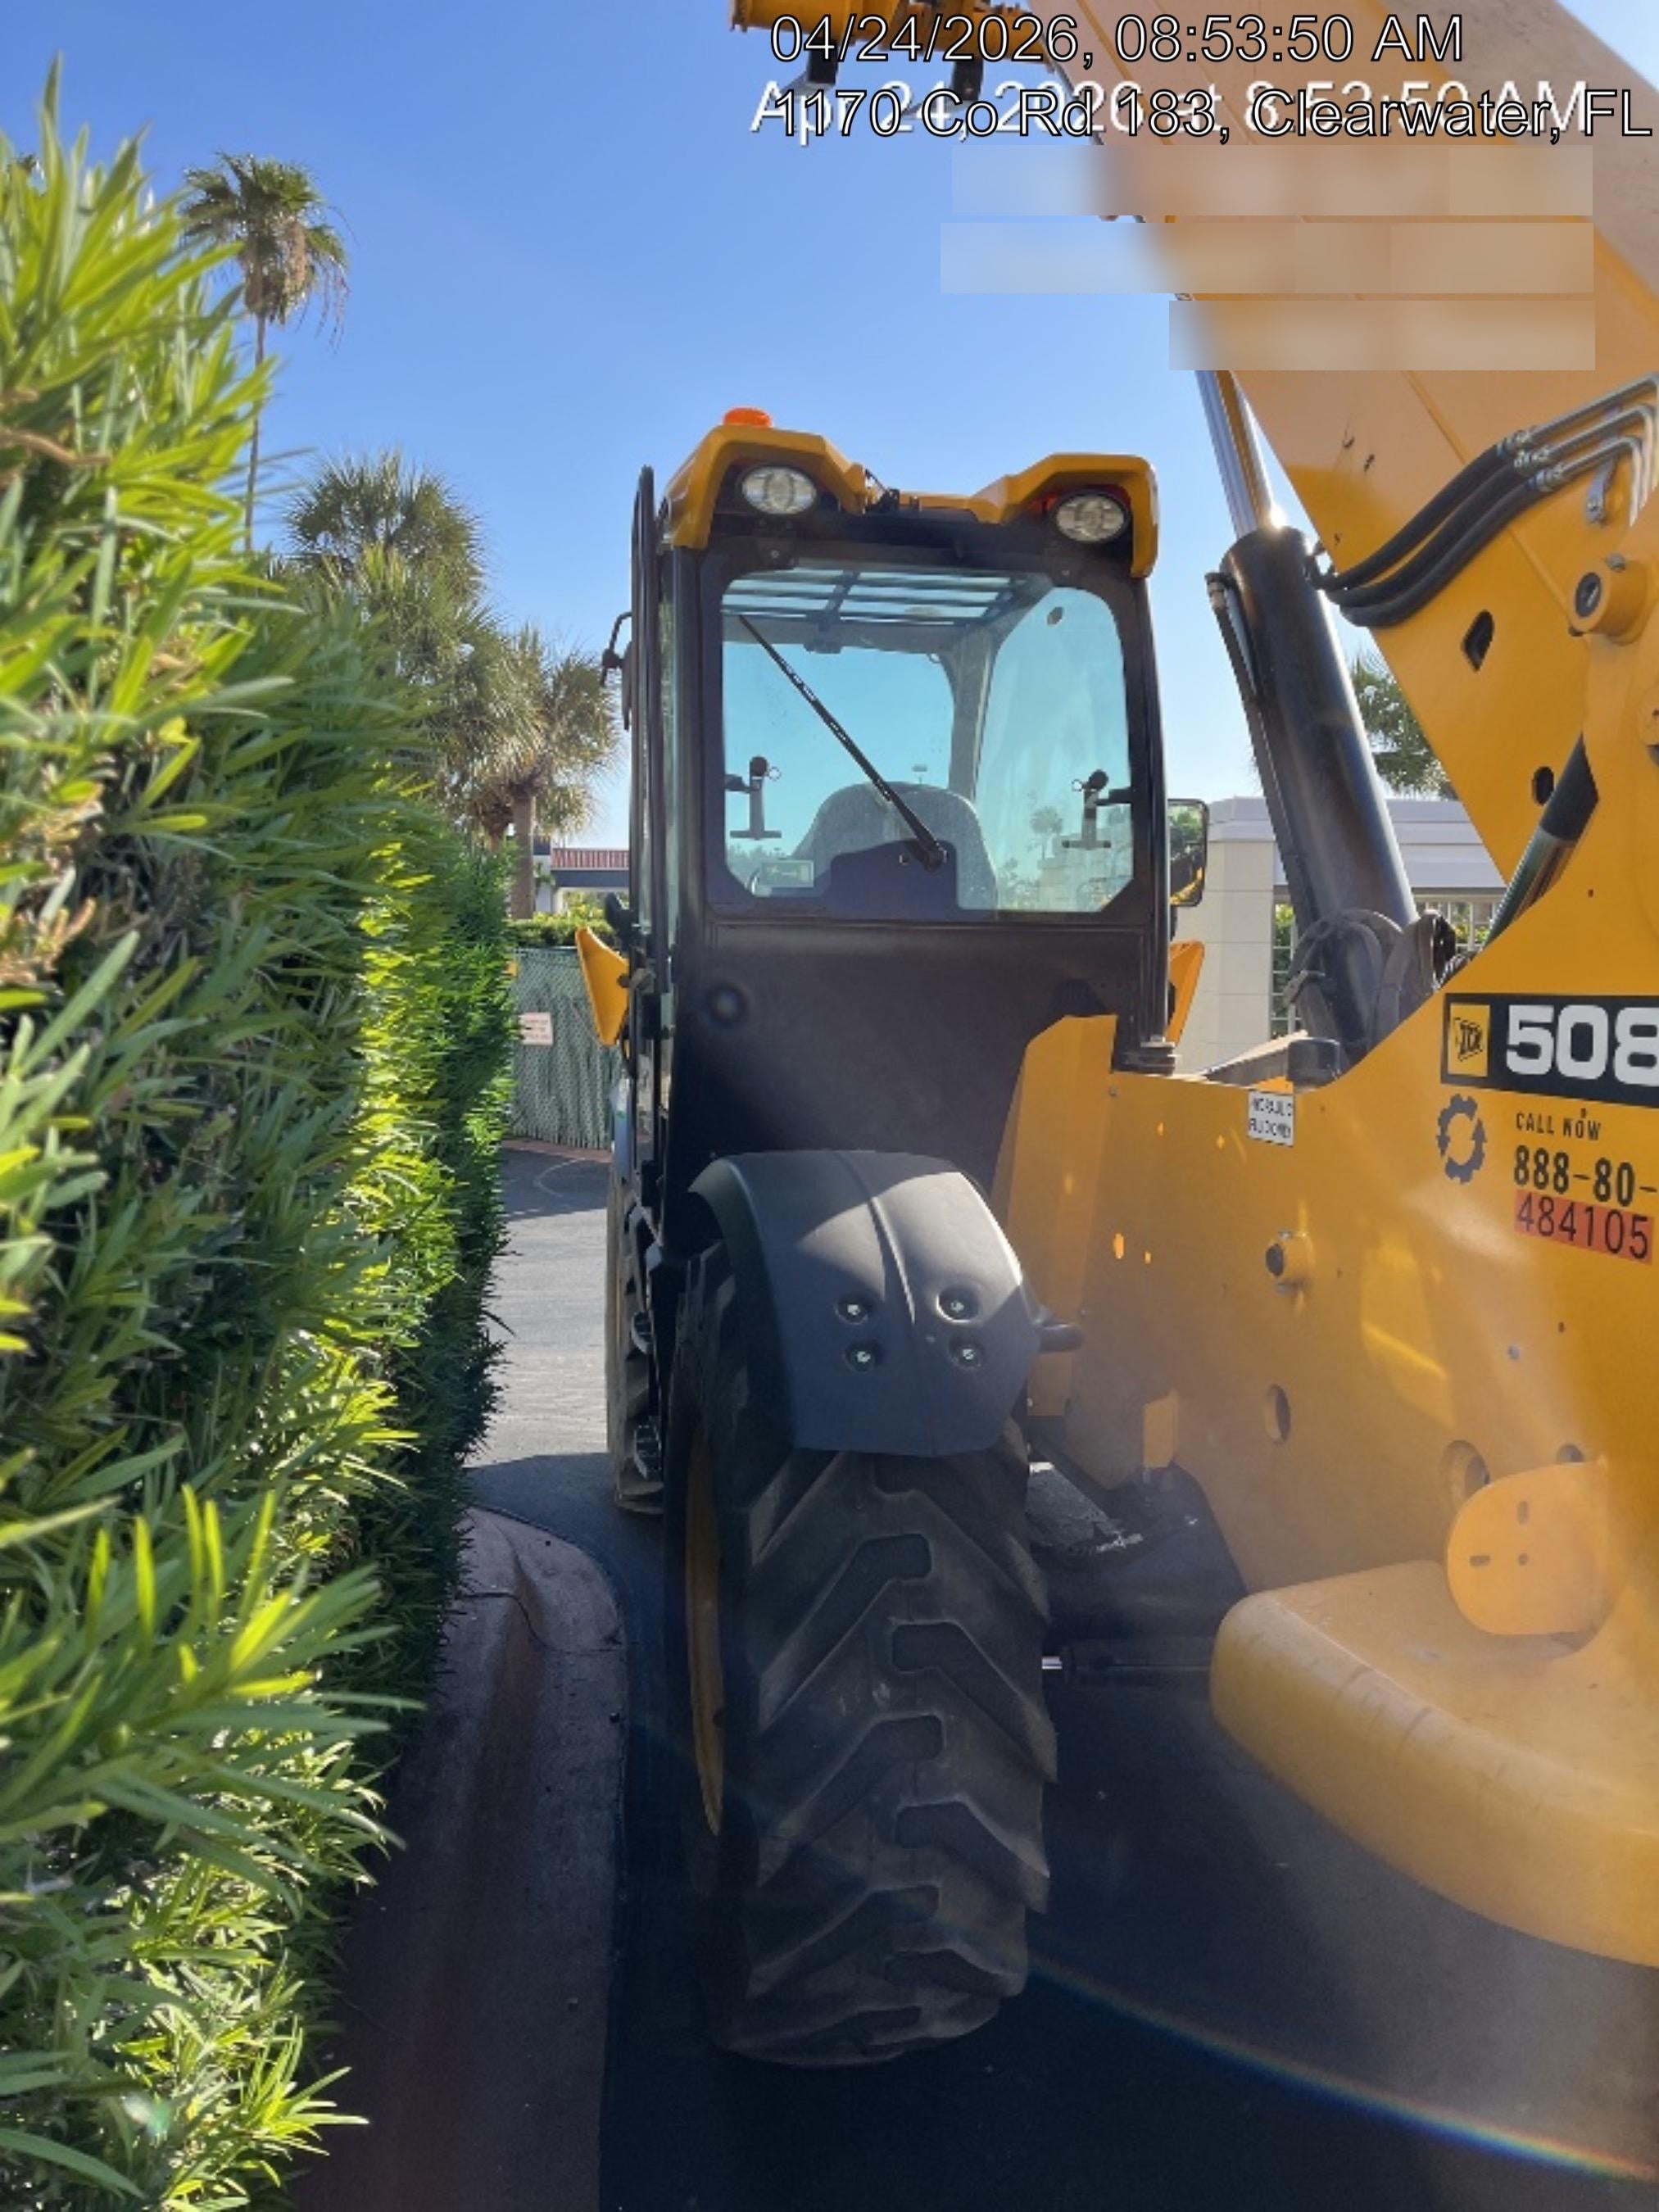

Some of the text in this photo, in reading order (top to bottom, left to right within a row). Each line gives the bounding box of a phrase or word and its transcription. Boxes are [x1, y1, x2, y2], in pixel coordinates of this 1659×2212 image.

[1516, 1112, 1602, 1140] CALL NOW
[1517, 1192, 1649, 1259] 484105
